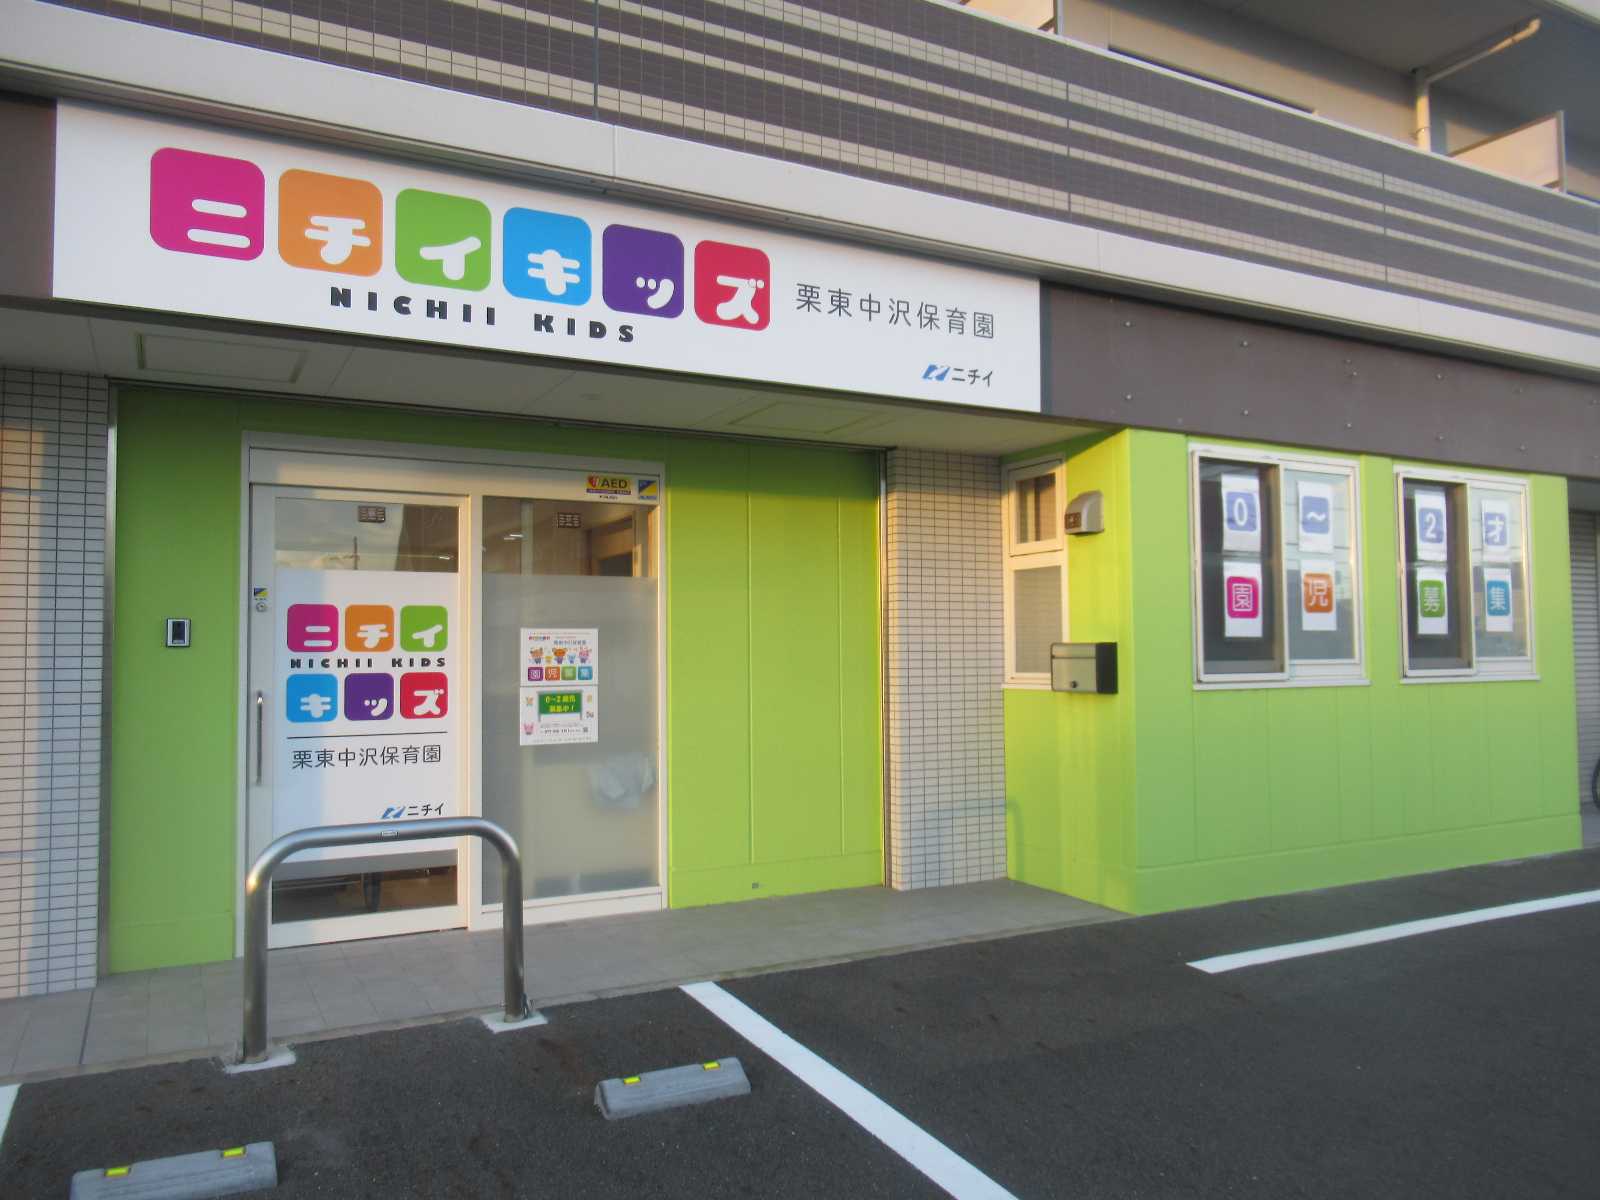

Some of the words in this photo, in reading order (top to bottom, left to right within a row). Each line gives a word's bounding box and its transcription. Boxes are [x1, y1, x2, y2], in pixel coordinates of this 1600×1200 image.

[186, 198, 766, 326] ニチイキッズ
[330, 286, 496, 326] NICHII
[533, 313, 634, 343] KIDS
[795, 283, 995, 339] 栗東中沢保育園
[951, 367, 994, 388] ニチイ
[601, 478, 628, 489] AED
[290, 658, 373, 669] NICHII
[391, 657, 446, 668] KIDS
[298, 686, 446, 719] キッズ
[291, 744, 441, 769] 栗東中沢保育園
[407, 802, 445, 816] ニチイ
